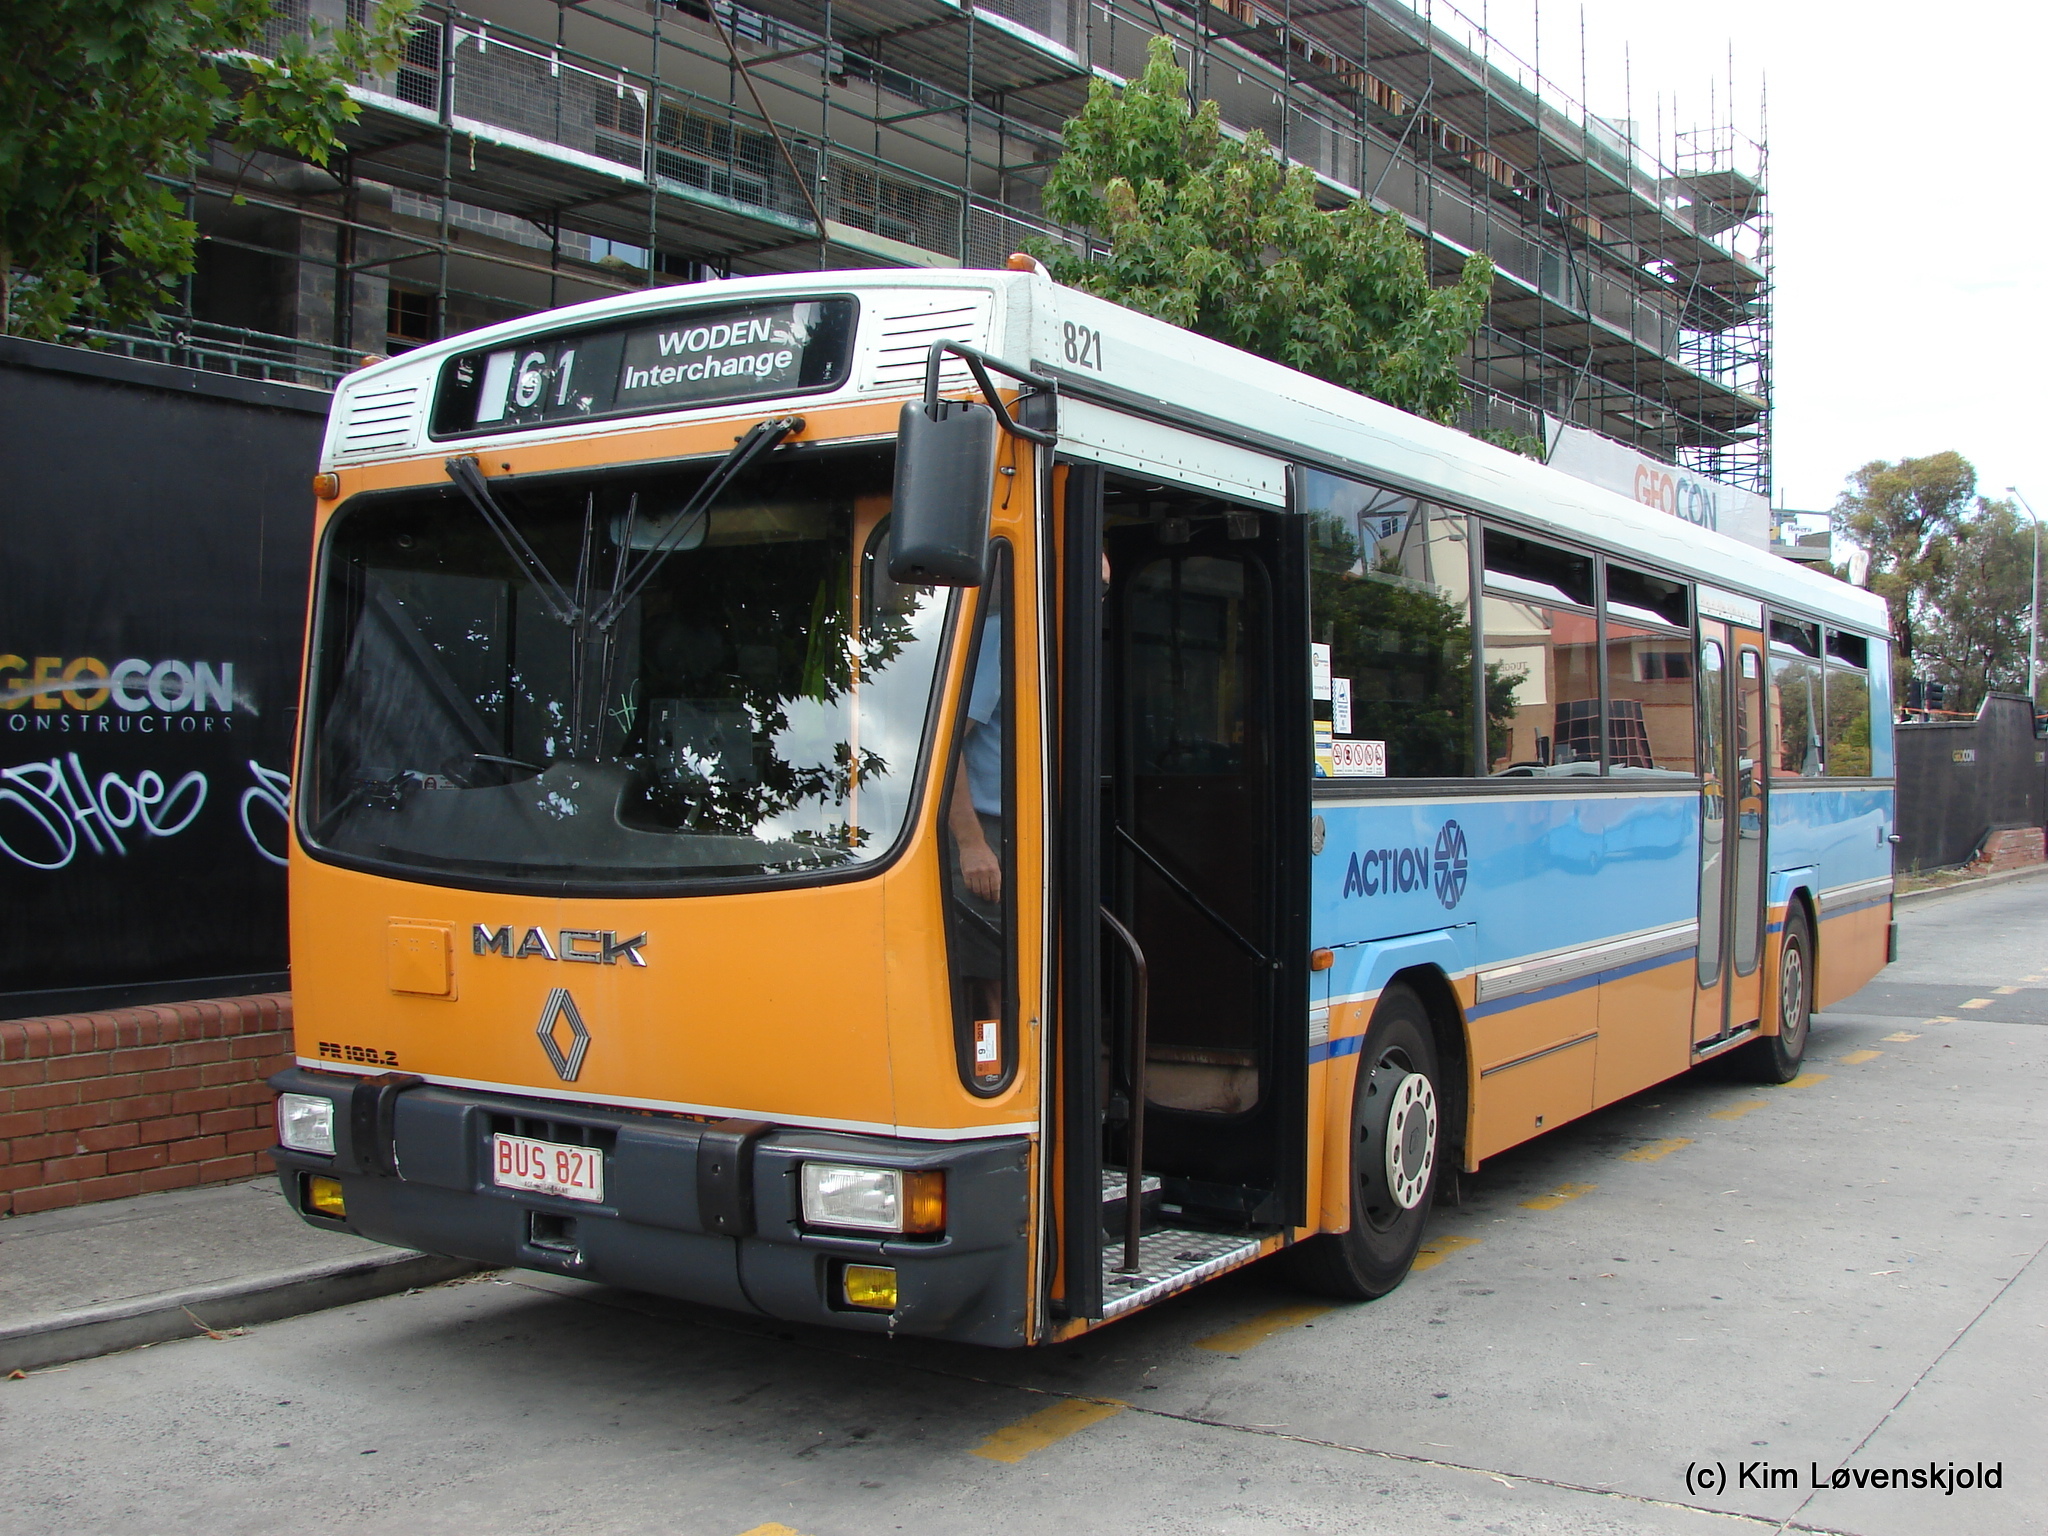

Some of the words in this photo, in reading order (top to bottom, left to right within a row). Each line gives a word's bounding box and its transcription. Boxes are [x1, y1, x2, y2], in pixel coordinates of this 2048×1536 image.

[659, 318, 772, 357] WODEN
[1063, 320, 1103, 372] 821
[515, 349, 576, 408] 61
[624, 348, 793, 389] Interchange
[1634, 463, 1717, 532] GEOCON
[0, 654, 233, 712] GEOCON
[9, 714, 233, 733] ONSTRUCTORS
[1343, 845, 1429, 899] ACTION
[472, 922, 648, 968] MACK
[318, 1041, 343, 1059] PR
[344, 1045, 399, 1067] 100.2
[499, 1140, 546, 1180] BUS
[556, 1151, 594, 1189] 821
